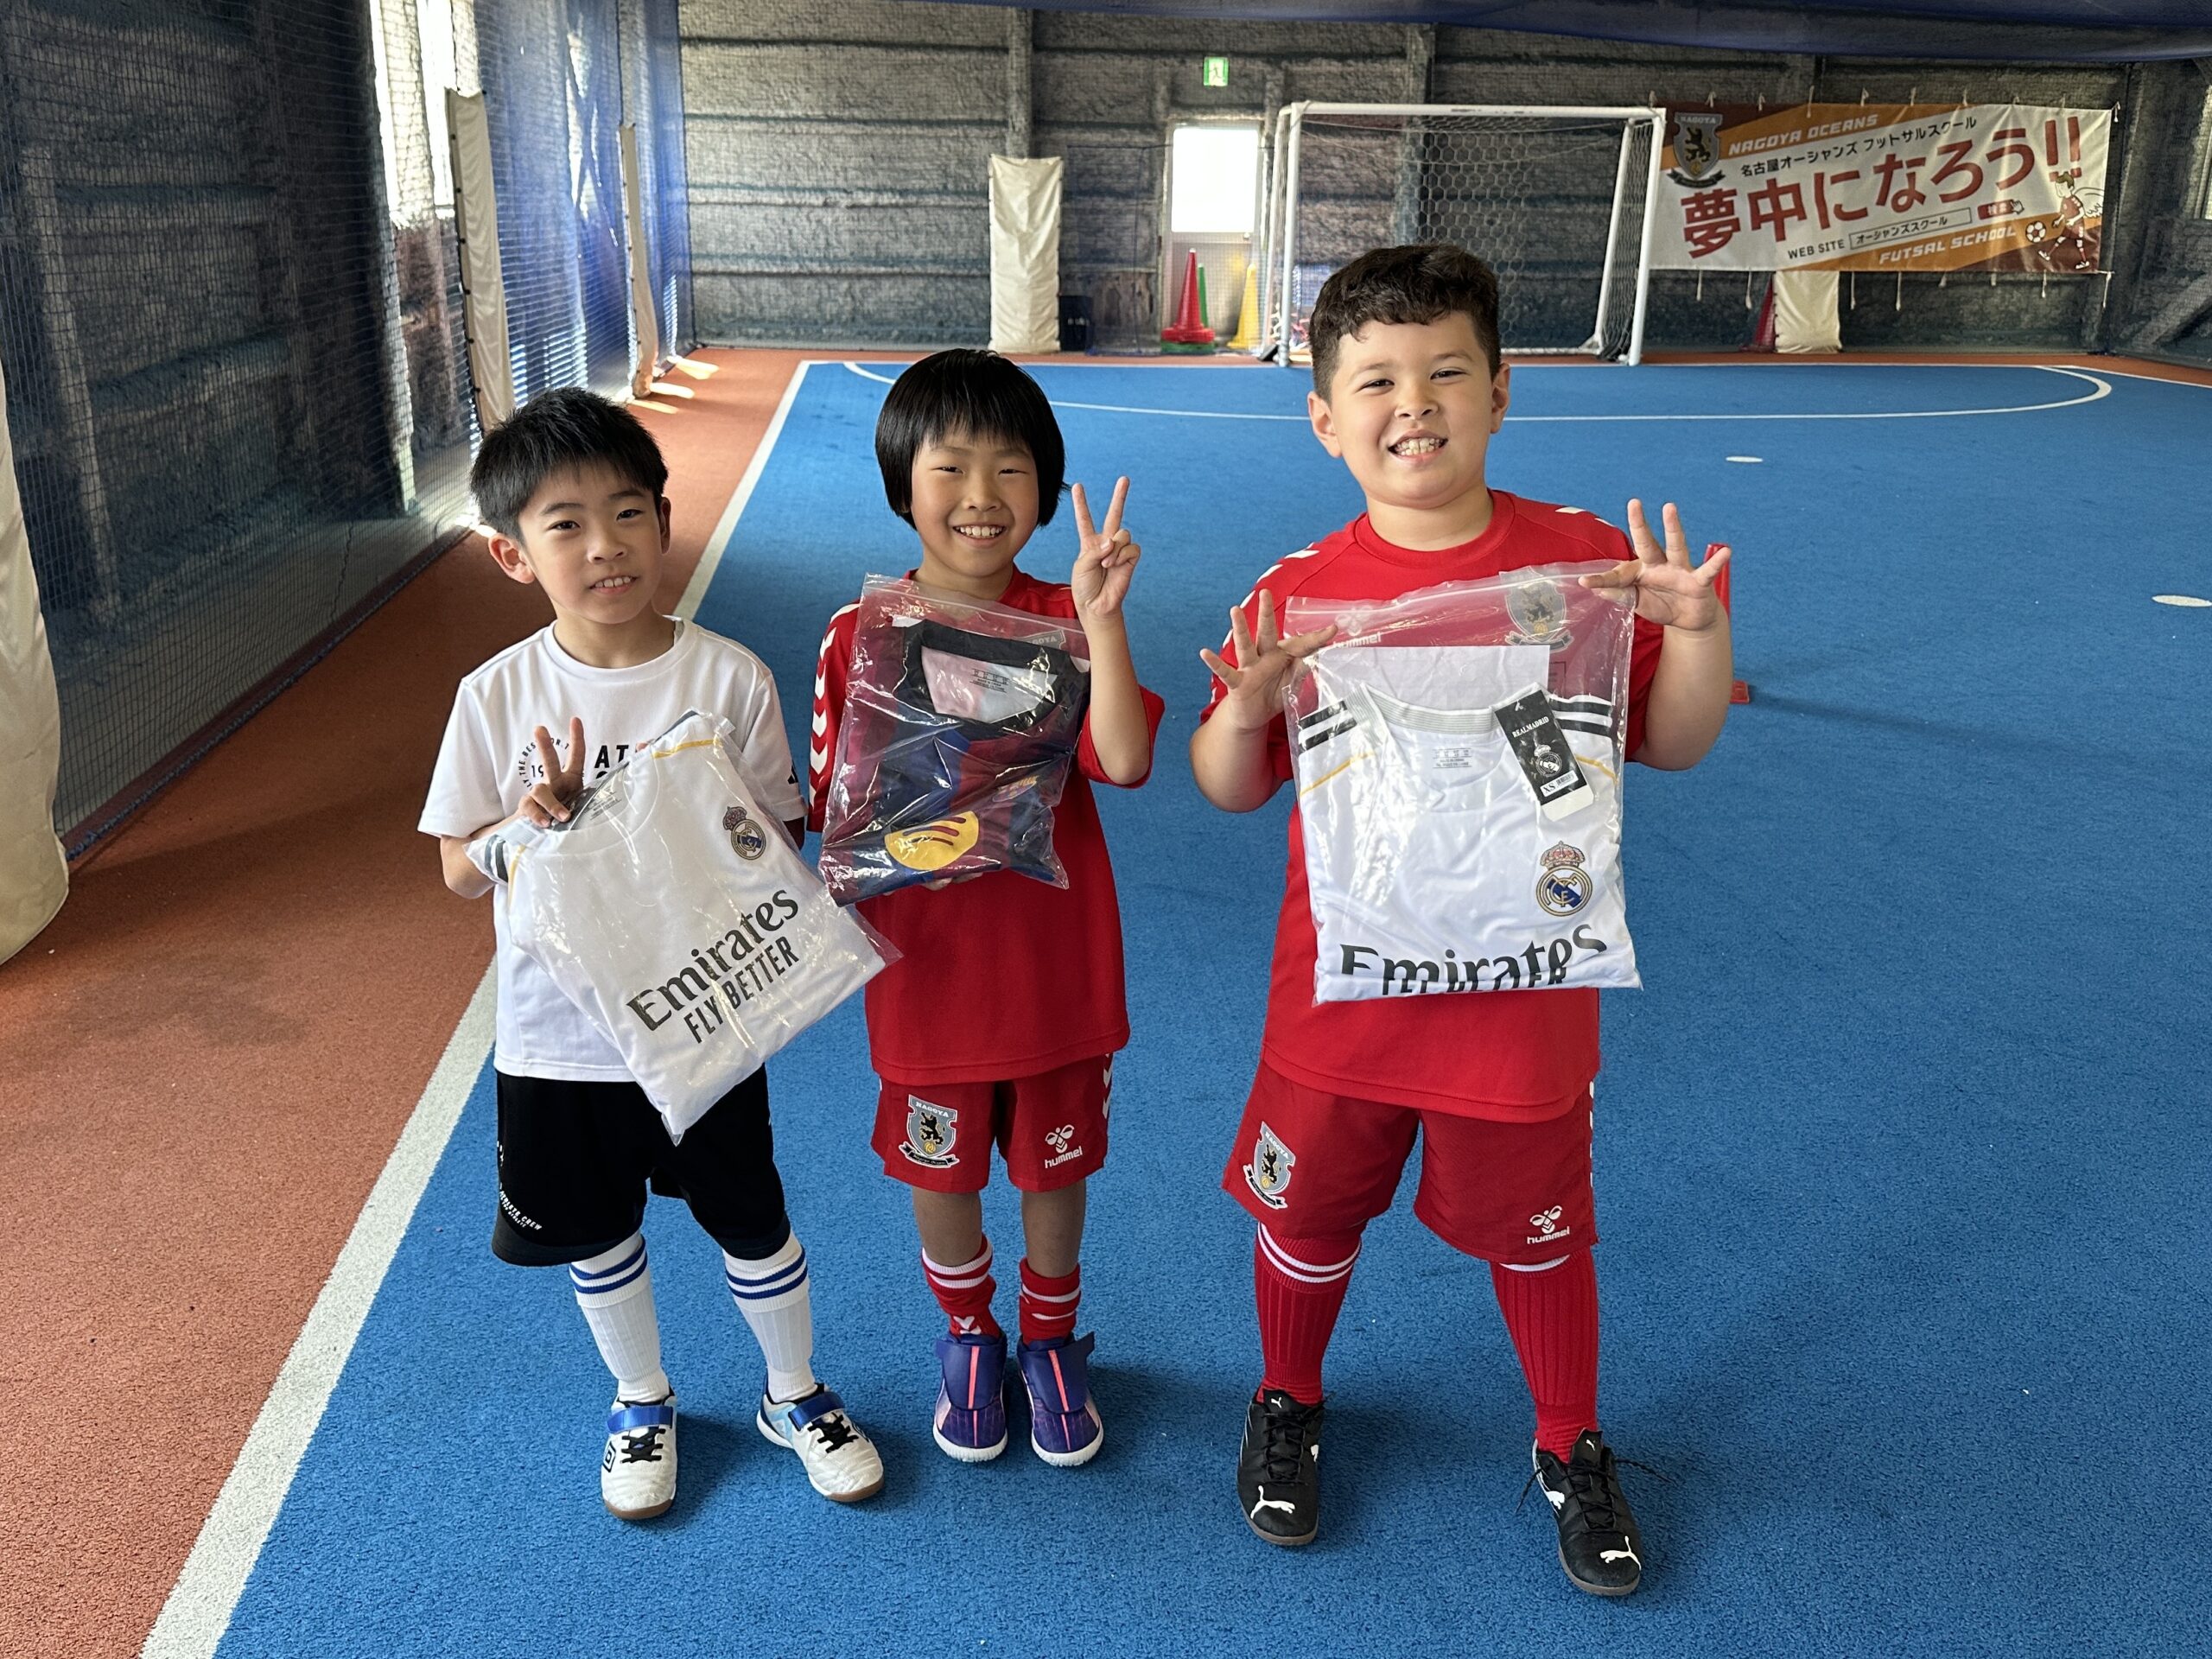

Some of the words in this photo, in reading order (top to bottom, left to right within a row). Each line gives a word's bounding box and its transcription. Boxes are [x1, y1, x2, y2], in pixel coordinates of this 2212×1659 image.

[1680, 116, 1717, 124] NAGOYA
[1728, 129, 1802, 156] NAGOYA
[1807, 113, 1879, 140] OCEANS
[1740, 141, 1858, 178] 名古屋オーシャンズ
[1863, 117, 1977, 152] フットサルスクール
[1855, 215, 1948, 245] オーシャンズスクール
[1788, 245, 1815, 260] WEB
[1818, 238, 1845, 254] SITE
[1878, 242, 1946, 265] FUTSAL
[1949, 226, 2017, 250] SCHOOL
[522, 741, 537, 758] BES
[1542, 782, 1556, 794] XS
[626, 889, 799, 1032] Emirates
[1339, 924, 1608, 985] Emirates
[683, 995, 724, 1044] FLY
[721, 936, 800, 1009] BETTER
[915, 1101, 950, 1118] NAGOYA
[1044, 1146, 1084, 1168] hummel
[1264, 1131, 1289, 1160] NAGOYA
[520, 1215, 543, 1230] CREW
[1526, 1225, 1571, 1246] hummel
